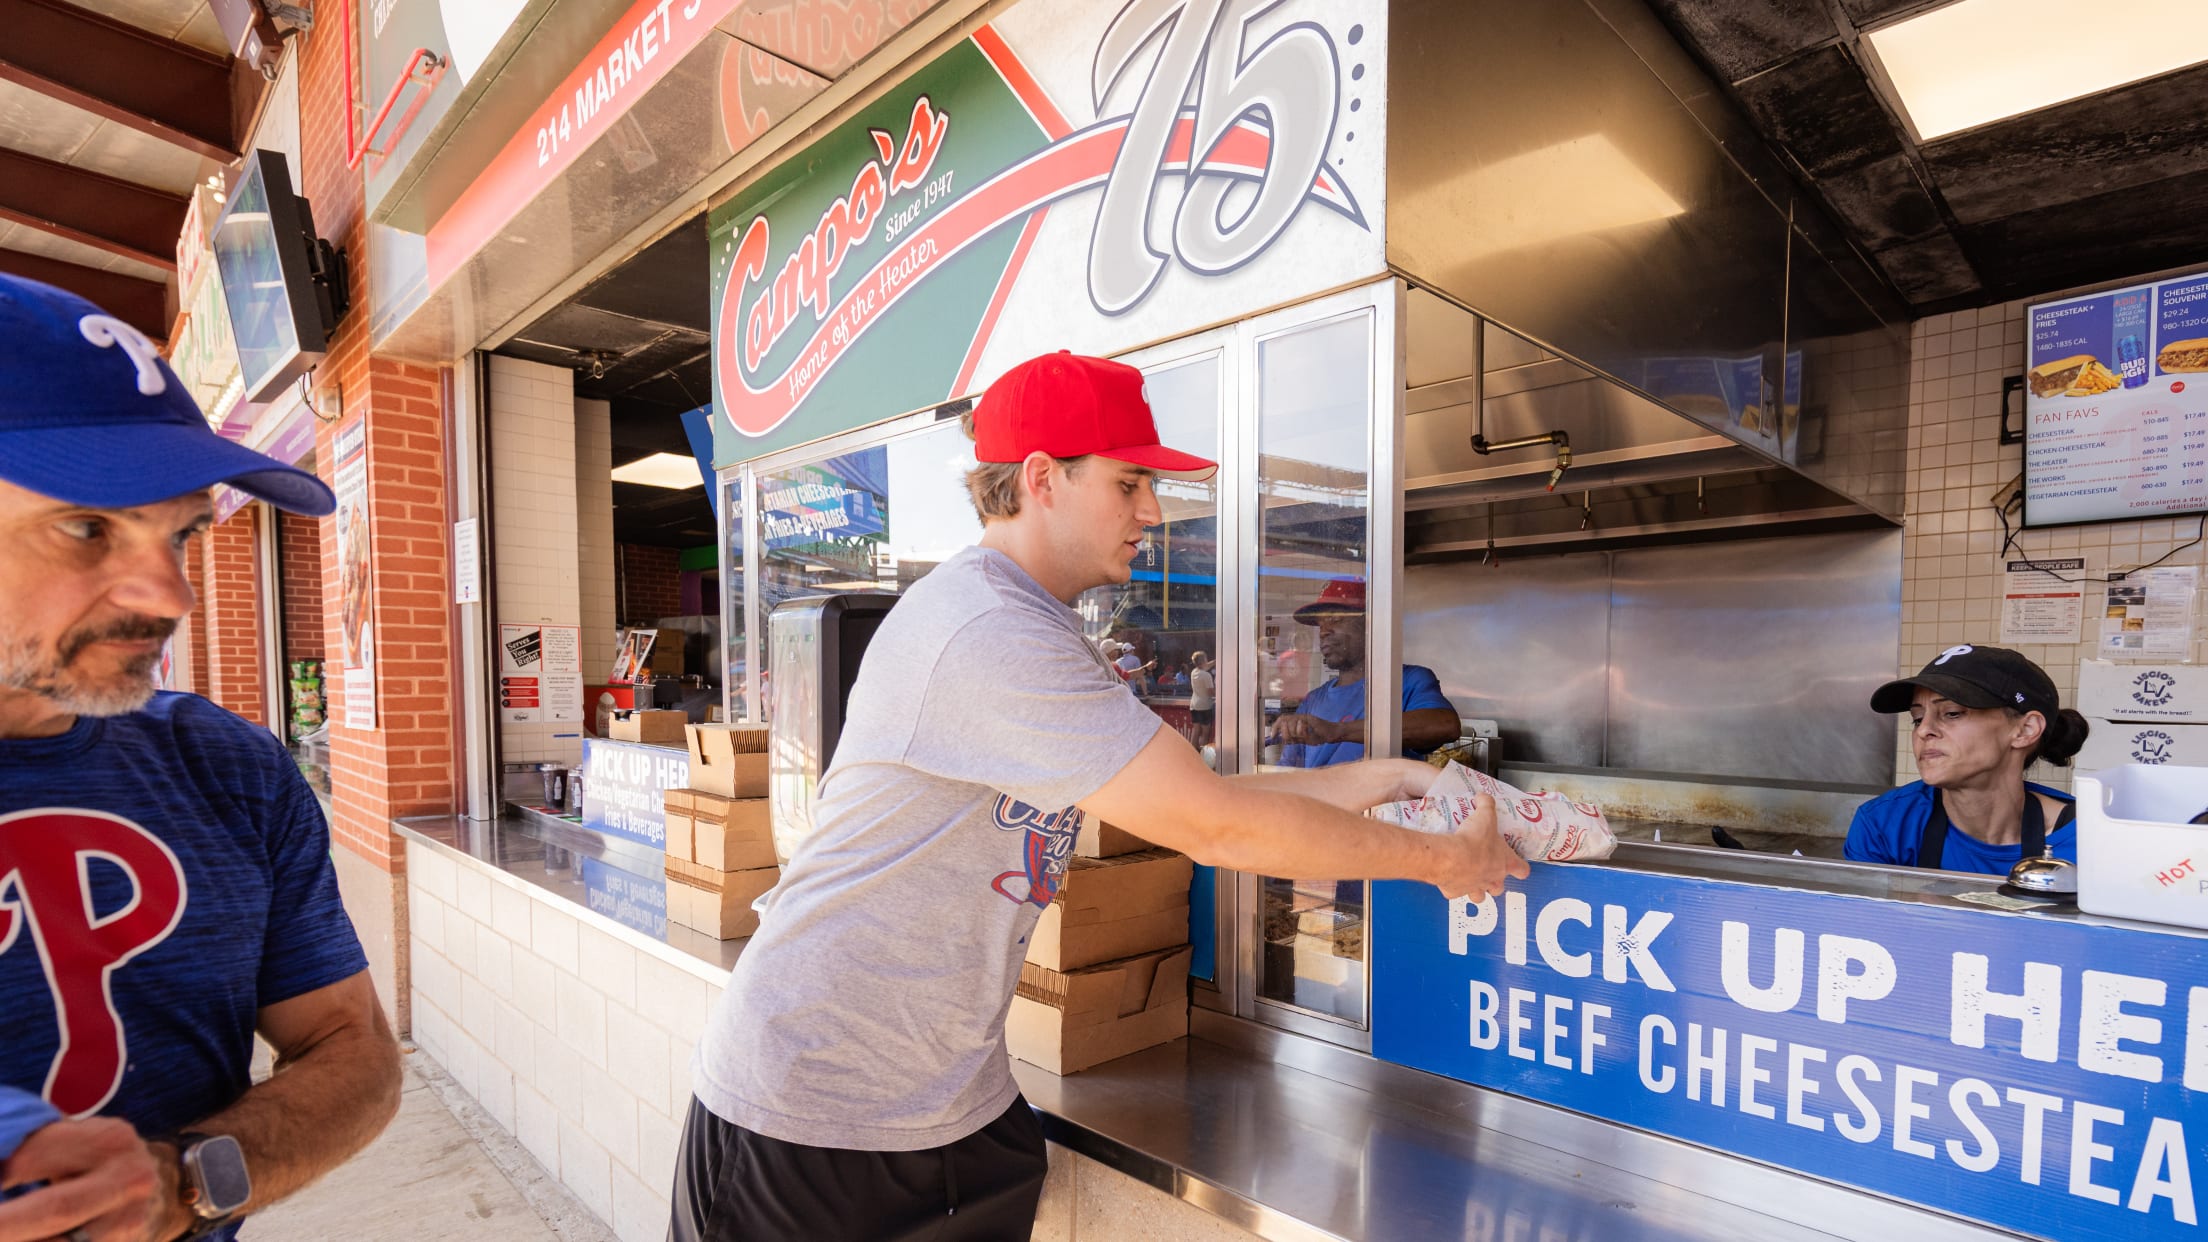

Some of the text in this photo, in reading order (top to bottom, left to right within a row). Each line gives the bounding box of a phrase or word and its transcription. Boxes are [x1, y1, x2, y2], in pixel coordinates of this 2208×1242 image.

[536, 2, 672, 168] 214 MARKET
[884, 169, 955, 243] Since 1947
[719, 94, 950, 437] Campo's
[2163, 292, 2207, 306] SOUVENIR
[789, 236, 939, 401] Home of the Heater
[2035, 305, 2088, 321] CHEESESTEAK
[2163, 308, 2189, 318] $29.24
[2035, 319, 2057, 329] FRIES
[2163, 318, 2200, 330] 980-1320
[2035, 330, 2059, 341] $25.74
[2073, 337, 2088, 346] CAL
[2120, 357, 2146, 371] BUD
[2035, 407, 2100, 424] FAN FAVS
[2028, 429, 2075, 440] CHEESESTEAK
[2028, 447, 2058, 456] CHICKEN
[2058, 442, 2106, 452] CHEESESTEAK
[2041, 458, 2068, 466] HEATER
[2028, 491, 2069, 501] VEGETARIAN
[2069, 486, 2118, 496] CHEESESTEAK
[2151, 497, 2181, 506] calories
[2189, 495, 2203, 503] day
[2166, 502, 2206, 511] Additional
[507, 636, 530, 651] Serves
[513, 648, 527, 658] You
[517, 652, 539, 666] Right!
[2132, 670, 2176, 686] LISCIO'S
[2132, 691, 2174, 707] BAKERY
[2131, 729, 2174, 745] LISCIO'S
[2131, 751, 2173, 765] BAKERY
[590, 747, 626, 782] PICK
[629, 753, 651, 787] UP
[604, 805, 621, 829] Fries
[628, 810, 665, 843] Beverages
[2153, 858, 2195, 888] HOT
[1447, 890, 2208, 1095] PICK UP HE
[1468, 979, 2201, 1227] BEEF CHEESESTEA
